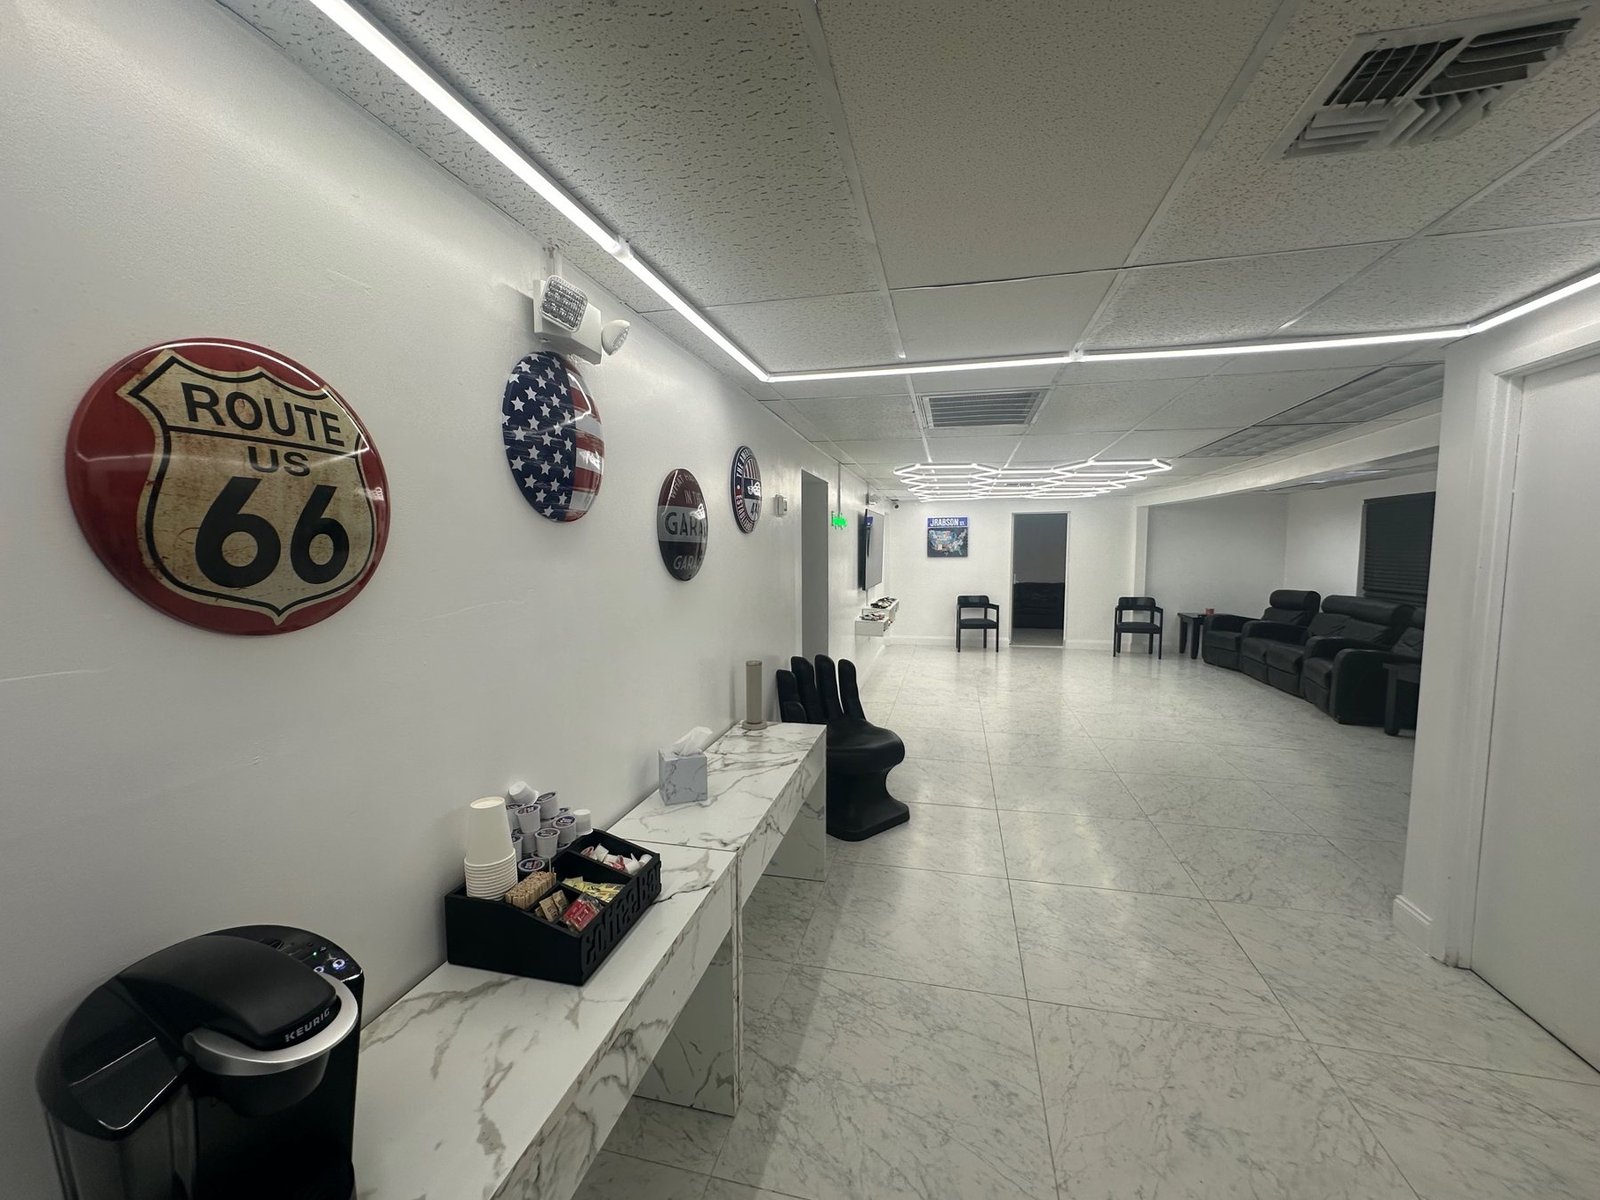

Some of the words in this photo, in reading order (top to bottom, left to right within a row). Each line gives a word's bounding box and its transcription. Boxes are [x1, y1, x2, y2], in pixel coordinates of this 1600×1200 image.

[181, 382, 345, 447] ROUTE
[247, 446, 311, 477] US
[195, 476, 350, 588] 66
[284, 1007, 331, 1042] KEURIG
